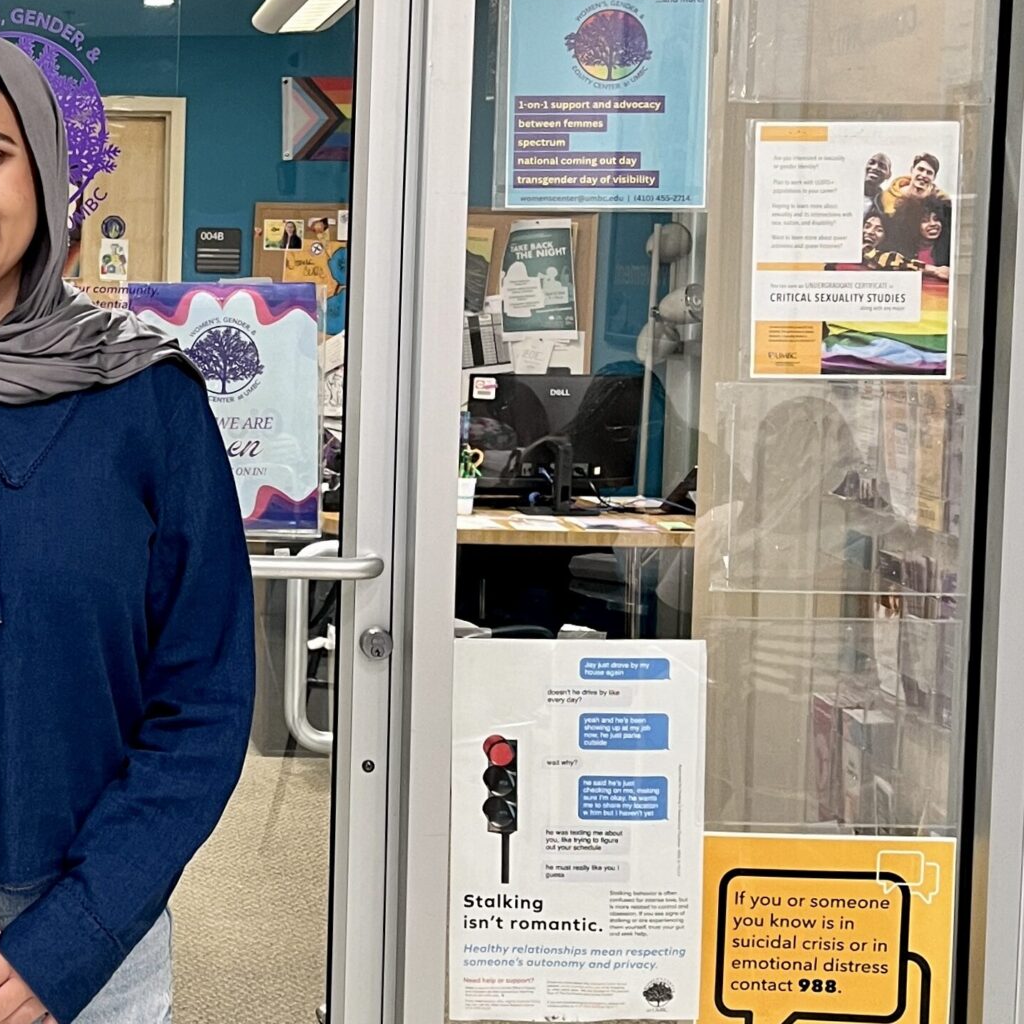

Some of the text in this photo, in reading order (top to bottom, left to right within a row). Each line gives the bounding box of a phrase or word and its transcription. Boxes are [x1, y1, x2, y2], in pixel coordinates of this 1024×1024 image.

[10, 7, 85, 52] GENDER,
[86, 47, 102, 64] &
[518, 100, 661, 111] 1-on-1 support and advocacy
[518, 118, 604, 128] between femmes
[517, 138, 566, 148] spectrum
[517, 156, 637, 167] national coming out day
[517, 174, 656, 186] transgender day of visibility
[200, 231, 225, 241] 004B
[510, 241, 554, 253] TAKE BACK
[515, 246, 567, 260] THE NIGHT
[770, 292, 906, 303] CRITICAL SEXUALITY STUDIES
[550, 388, 570, 396] DELL
[242, 417, 274, 430] ARE
[463, 894, 544, 913] Stalking
[734, 890, 890, 910] If you or someone
[463, 915, 604, 932] isn't romantic.
[732, 913, 855, 931] you know is in
[731, 935, 888, 953] suicidal crisis or in
[463, 944, 686, 958] Healthy relationships mean respecting
[463, 958, 658, 971] someone's autonomy and privacy.
[731, 956, 889, 974] emotional distress
[730, 977, 842, 994] contact 988.
